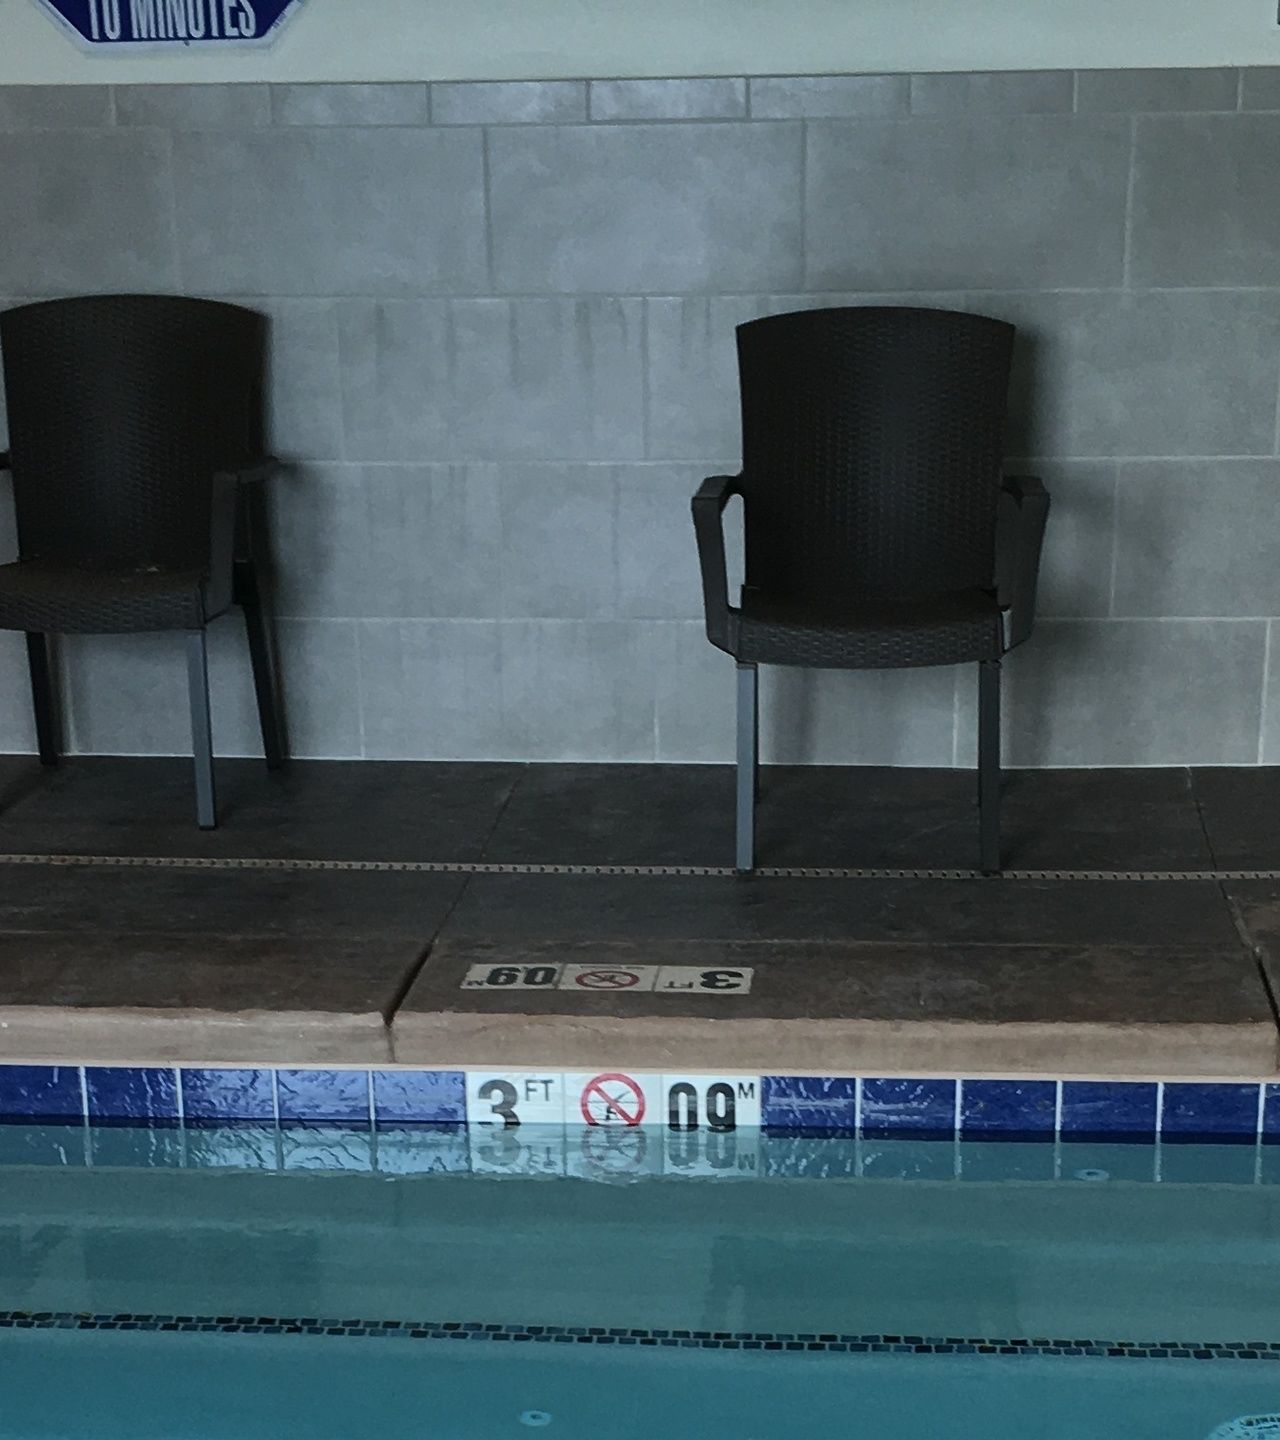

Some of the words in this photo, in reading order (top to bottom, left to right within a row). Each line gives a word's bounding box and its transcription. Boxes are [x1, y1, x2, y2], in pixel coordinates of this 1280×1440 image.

[129, 0, 257, 39] MINUTES
[700, 970, 744, 990] 3
[478, 1079, 521, 1126] 3
[525, 1079, 554, 1101] FT
